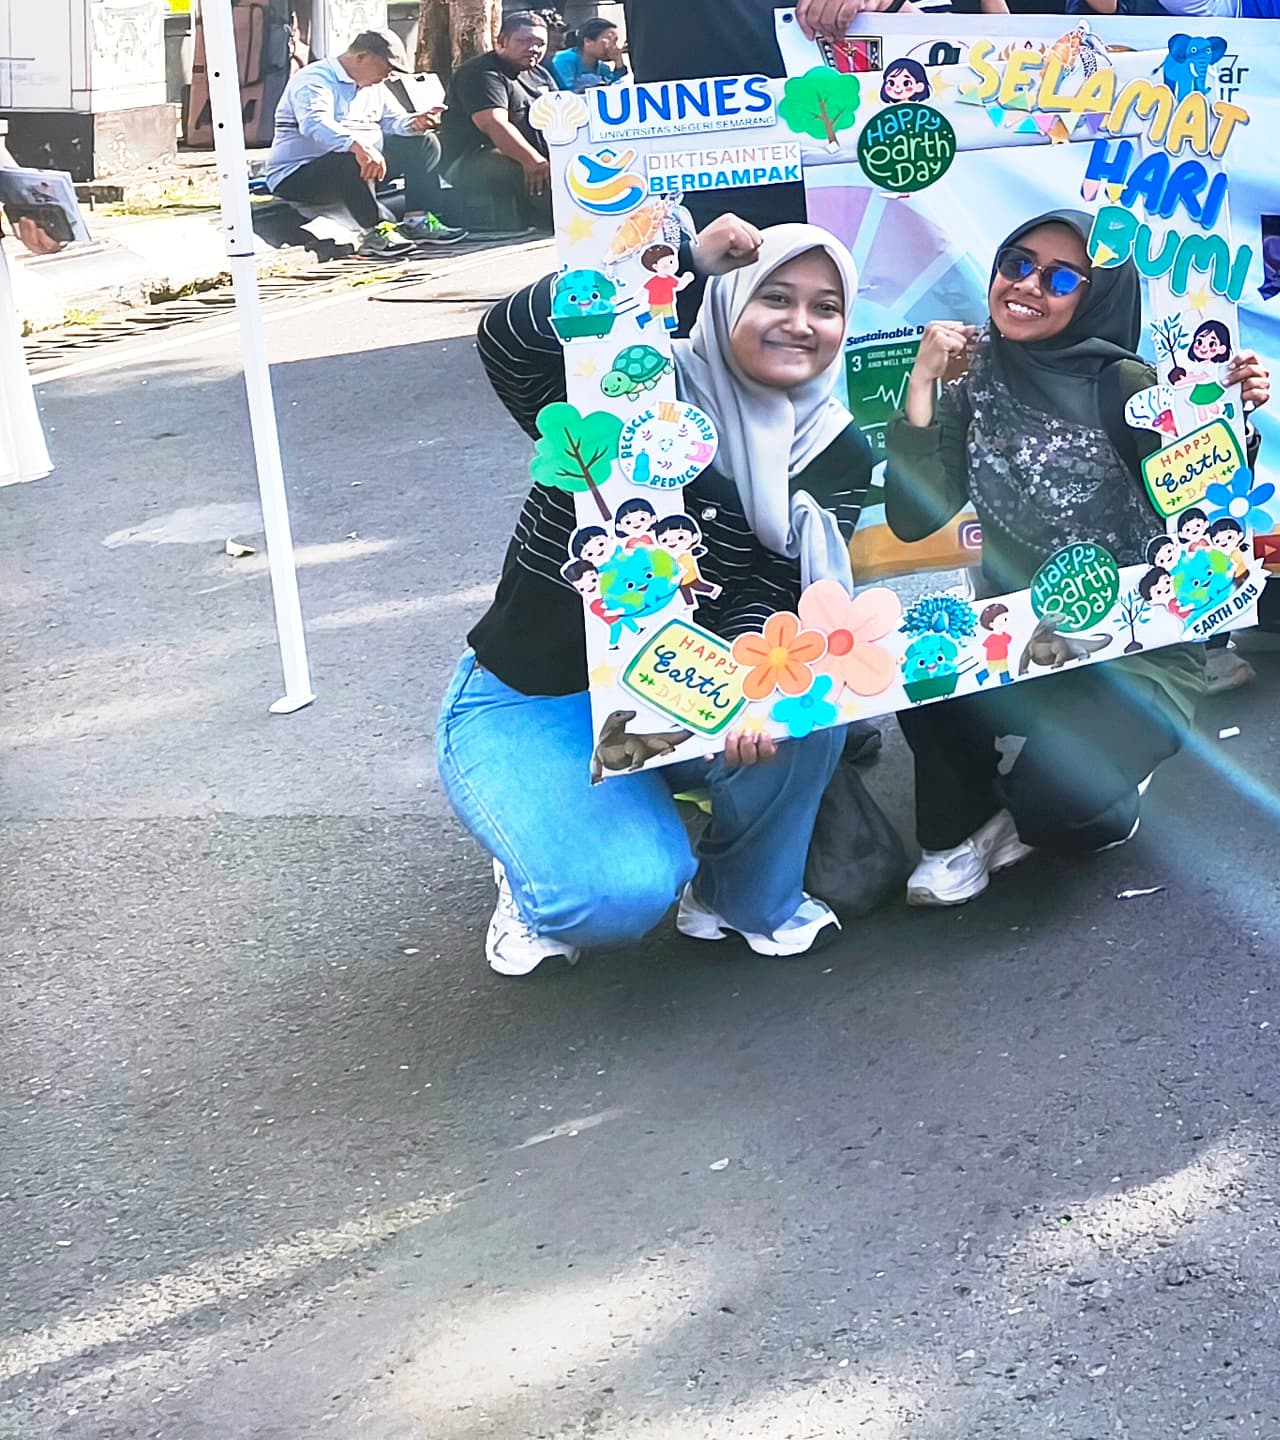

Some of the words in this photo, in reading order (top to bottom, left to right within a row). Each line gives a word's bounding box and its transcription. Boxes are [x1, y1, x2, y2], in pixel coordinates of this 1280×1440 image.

[597, 77, 772, 125] UNNES
[958, 39, 1249, 158] SELAMAT
[599, 123, 671, 140] UNIVERSITAS
[673, 121, 714, 133] NEGERI
[716, 115, 774, 128] SEMARANG
[648, 145, 798, 170] DIKTISAINTEK
[887, 161, 942, 187] Day
[650, 165, 799, 192] BERDAMPAK
[1081, 138, 1229, 229] HARI
[1087, 206, 1253, 303] BUMI
[846, 327, 914, 346] Sustainable
[852, 356, 861, 372] 3
[621, 410, 655, 459] RECYCLE
[684, 408, 715, 441] REUSE
[1155, 445, 1232, 493] Earth
[1160, 432, 1212, 468] HAPPY
[650, 464, 700, 488] REDUCE
[1069, 587, 1113, 628] Day
[1193, 604, 1234, 636] EARTH
[1235, 583, 1259, 611] DAY
[679, 635, 738, 675] HAPPY
[653, 644, 730, 709] Earth
[656, 682, 697, 713] DAY
